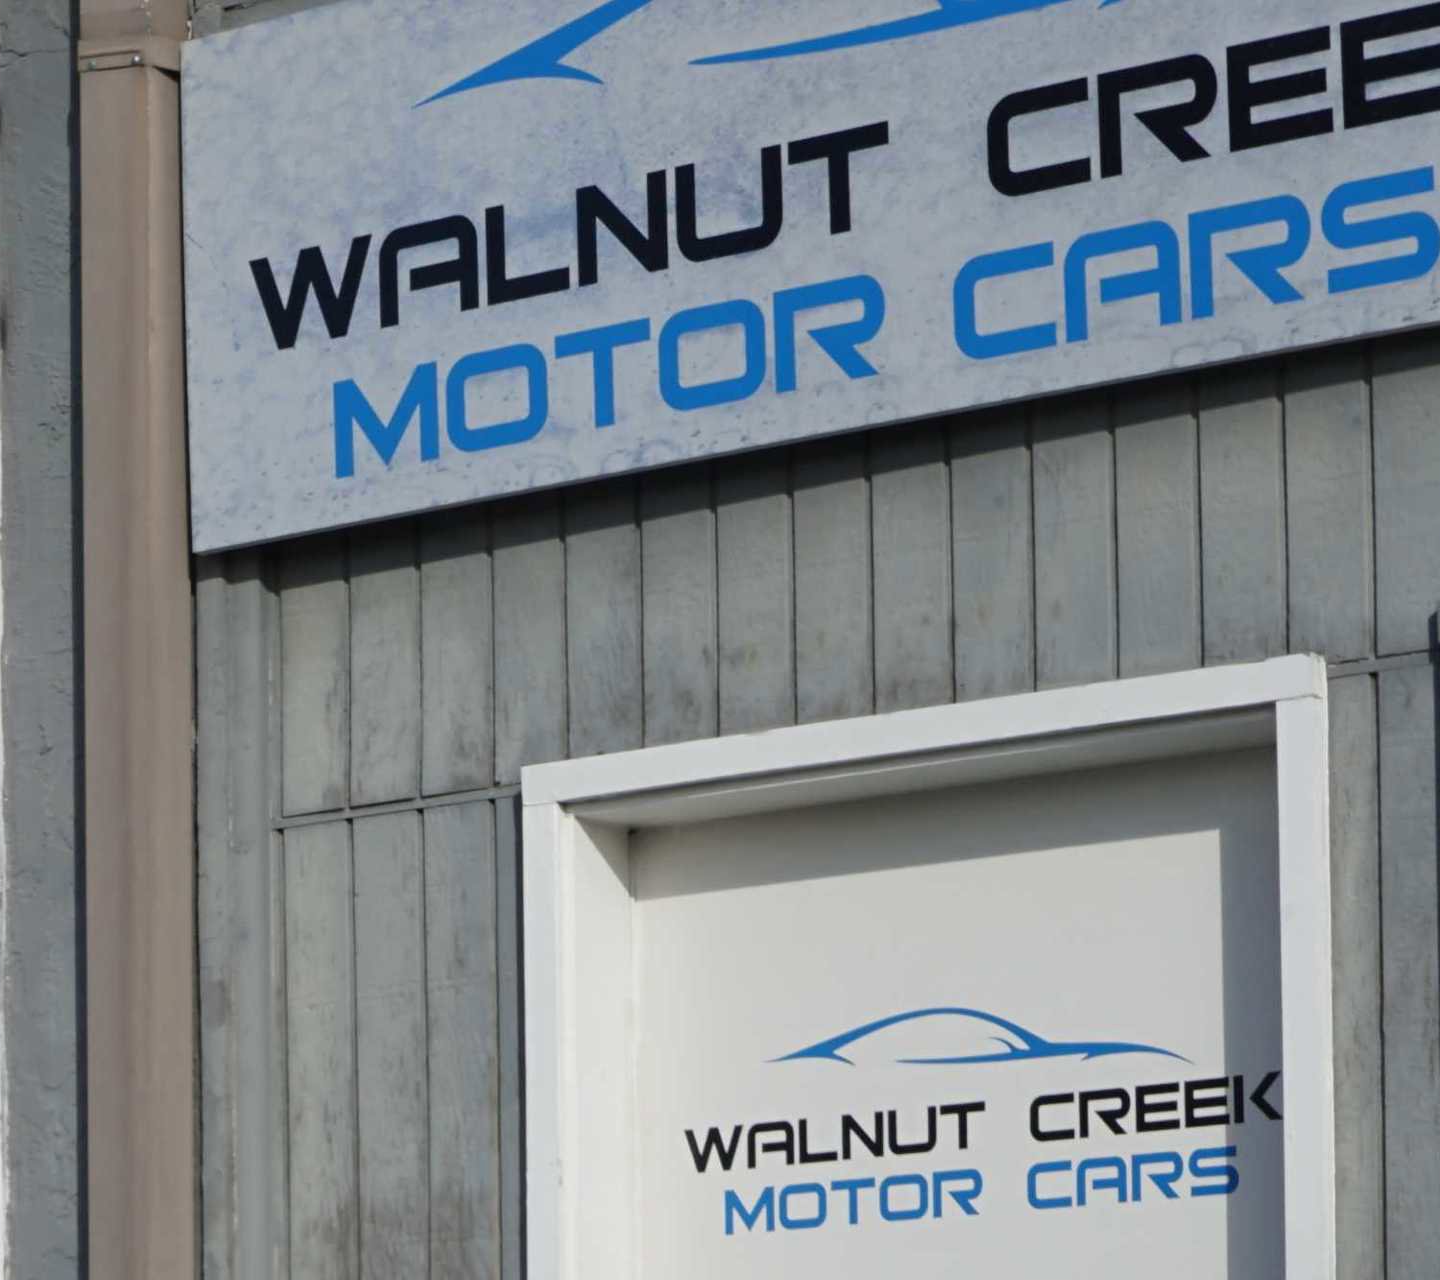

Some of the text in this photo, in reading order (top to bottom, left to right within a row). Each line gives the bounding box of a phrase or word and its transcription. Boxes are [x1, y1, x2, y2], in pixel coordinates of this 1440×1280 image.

[249, 121, 889, 350] WALNUT
[333, 274, 885, 478] MOTOR
[684, 1069, 1284, 1174] WALNUT CREEK
[723, 1144, 1241, 1236] MOTOR CARS
